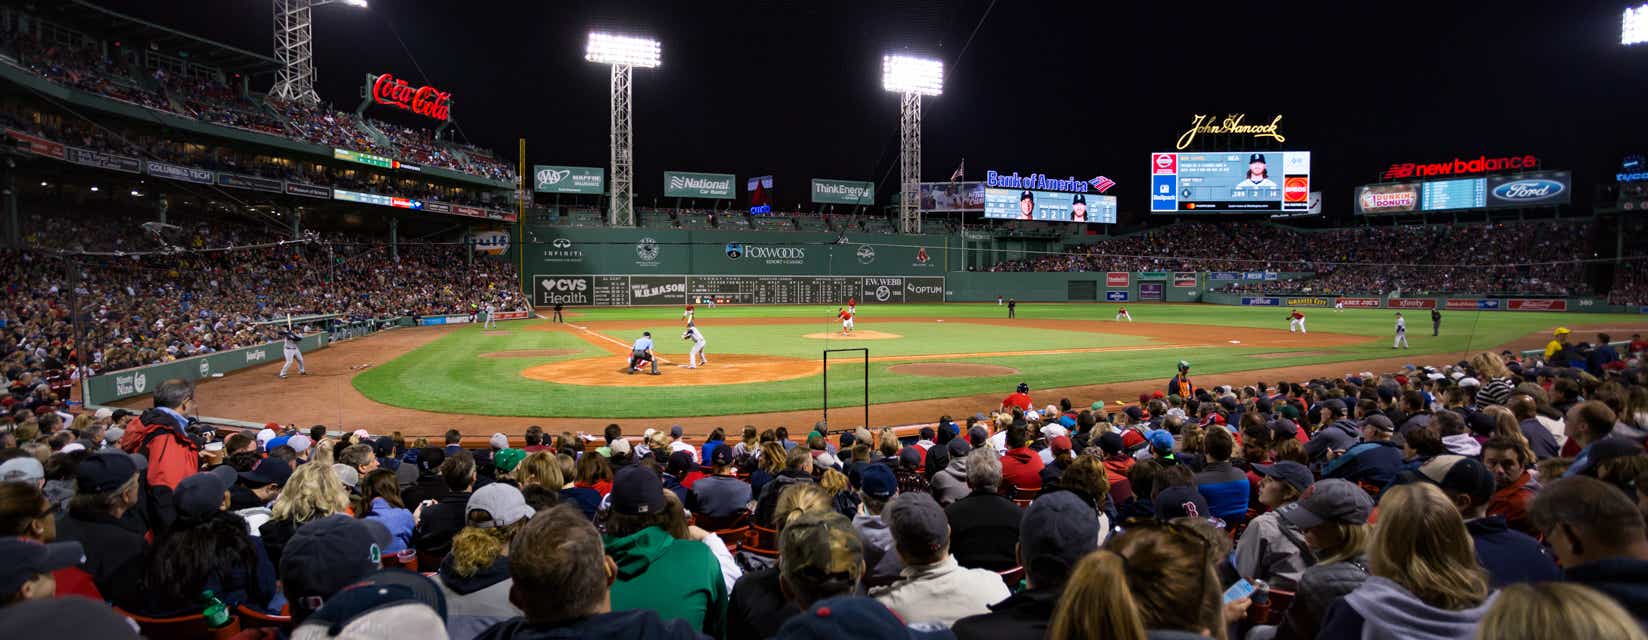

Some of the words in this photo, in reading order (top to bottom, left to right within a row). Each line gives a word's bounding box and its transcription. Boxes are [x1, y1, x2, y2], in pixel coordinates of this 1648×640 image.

[1176, 114, 1220, 150] John
[1221, 113, 1286, 143] Hancock
[1416, 162, 1452, 177] new
[1454, 155, 1536, 174] balance
[684, 177, 729, 190] National
[987, 170, 1022, 188] Bank
[1022, 173, 1036, 189] of
[1037, 174, 1088, 193] America
[1506, 183, 1550, 198] Ford
[556, 279, 587, 291] CVS
[915, 286, 942, 294] OPTUM
[544, 292, 587, 304] Health
